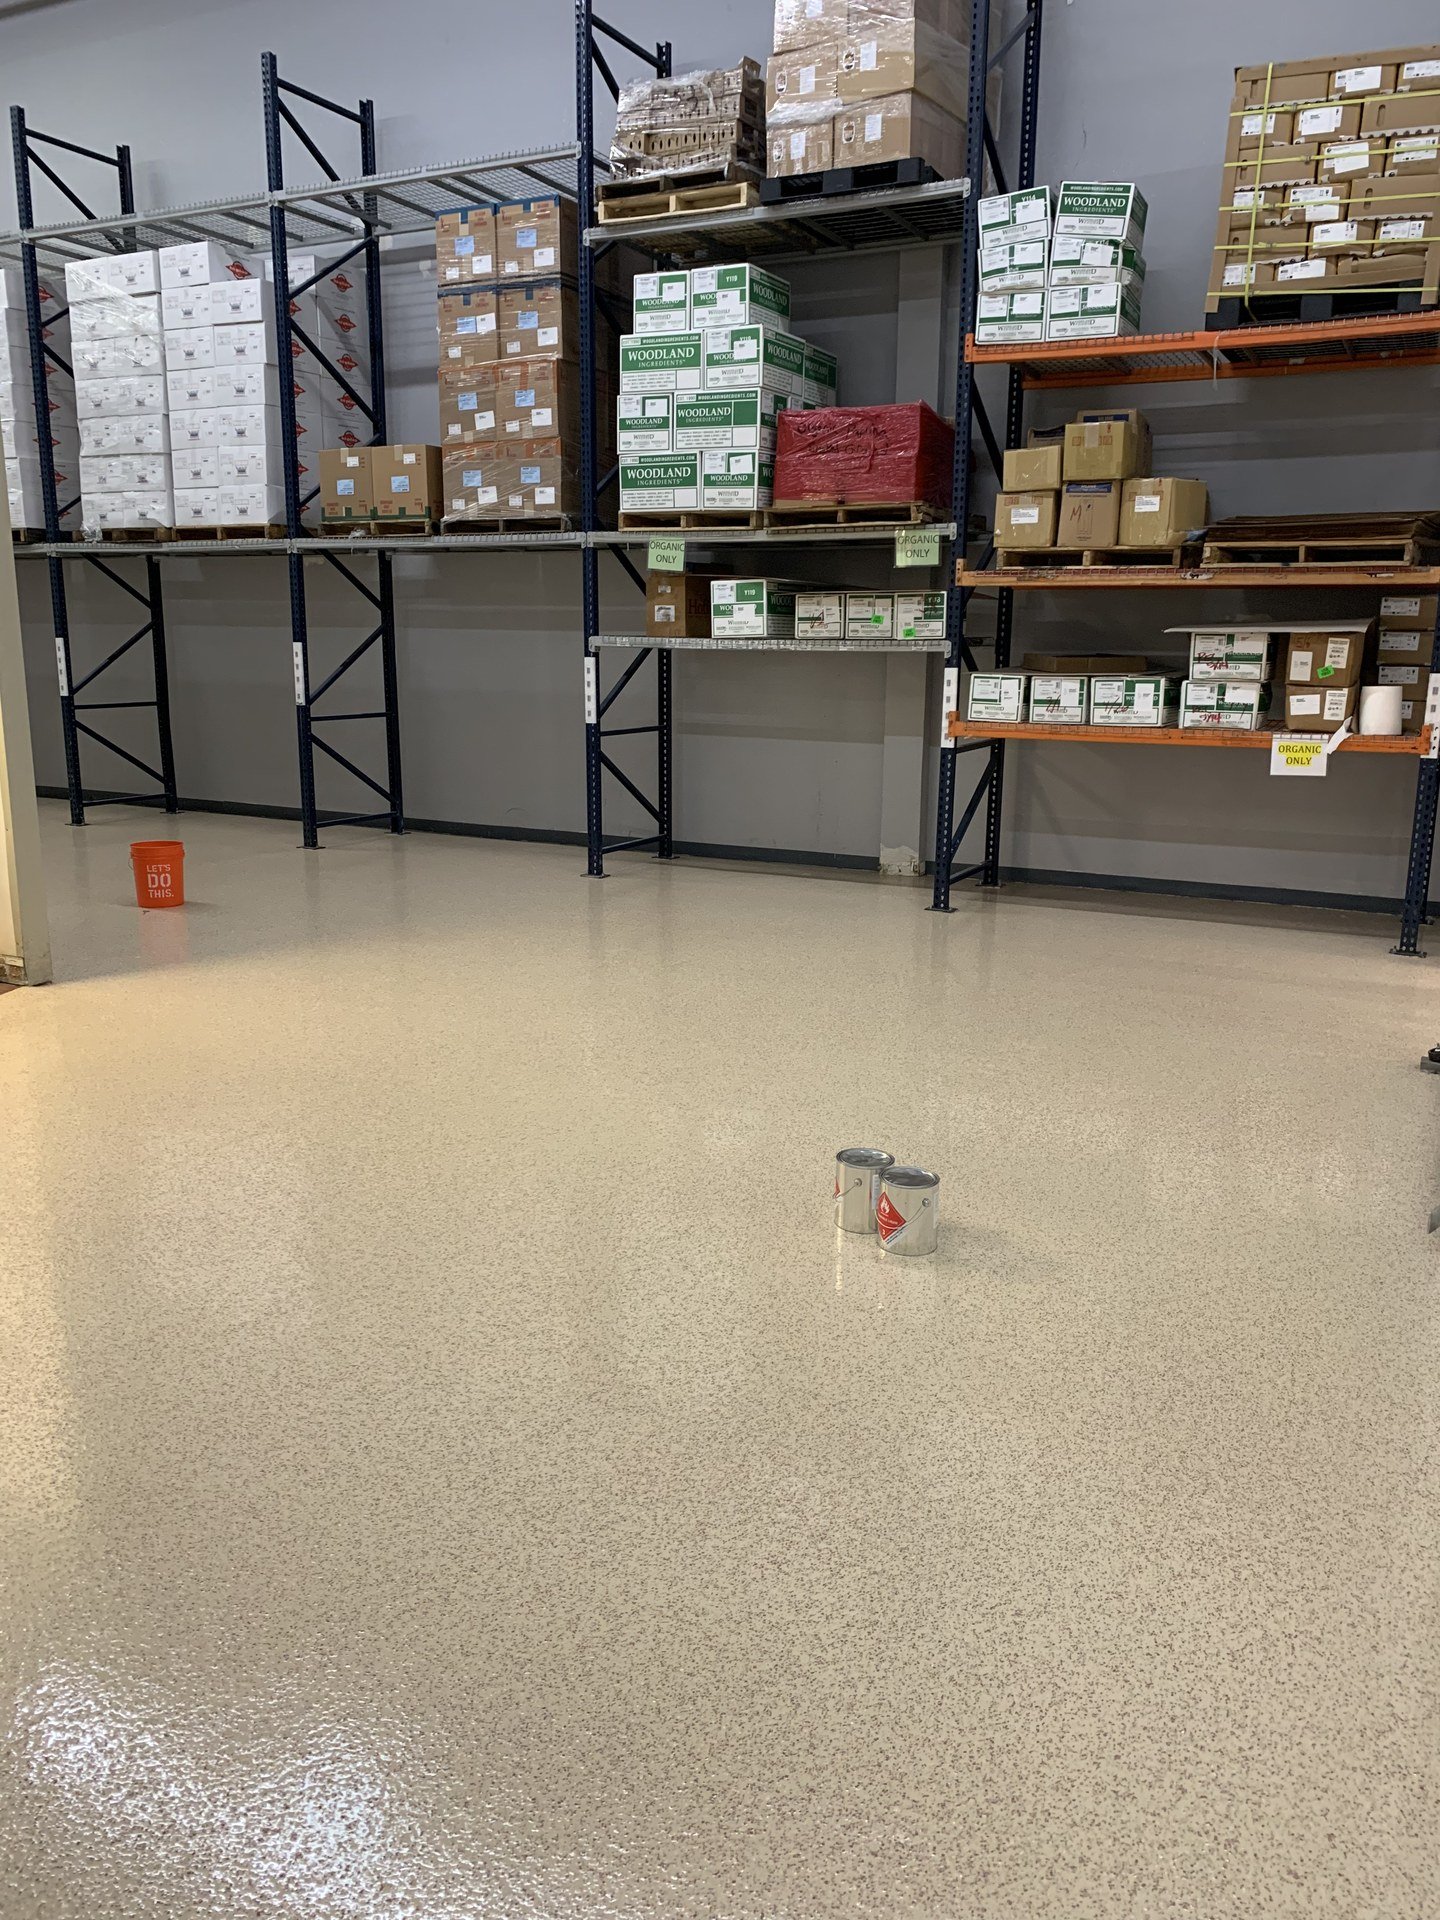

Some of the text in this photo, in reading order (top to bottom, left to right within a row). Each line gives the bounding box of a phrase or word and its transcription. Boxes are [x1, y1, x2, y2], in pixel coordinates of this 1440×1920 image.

[1063, 196, 1126, 208] WOODLAND
[752, 282, 788, 306] WOODLAND
[627, 346, 695, 362] WOODLAND
[767, 342, 802, 365] WOODLAND
[638, 359, 685, 368] INGREDIENTS
[677, 406, 731, 418] WOODLAND
[625, 417, 663, 426] WOODLAND
[685, 416, 724, 424] INGREDIENTS
[626, 466, 691, 480] WOODLAND
[710, 474, 748, 482] WOODLAND
[637, 478, 683, 487] INGREDIENTS
[897, 533, 940, 545] ORGANIC
[649, 540, 685, 552] ORGANIC
[655, 553, 678, 564] ONLY
[905, 548, 930, 559] ONLY
[1278, 744, 1322, 754] ORGANIC
[1285, 757, 1312, 766] ONLY
[146, 863, 171, 873] LET'S
[147, 873, 172, 888] DO
[147, 889, 175, 899] THIS.
